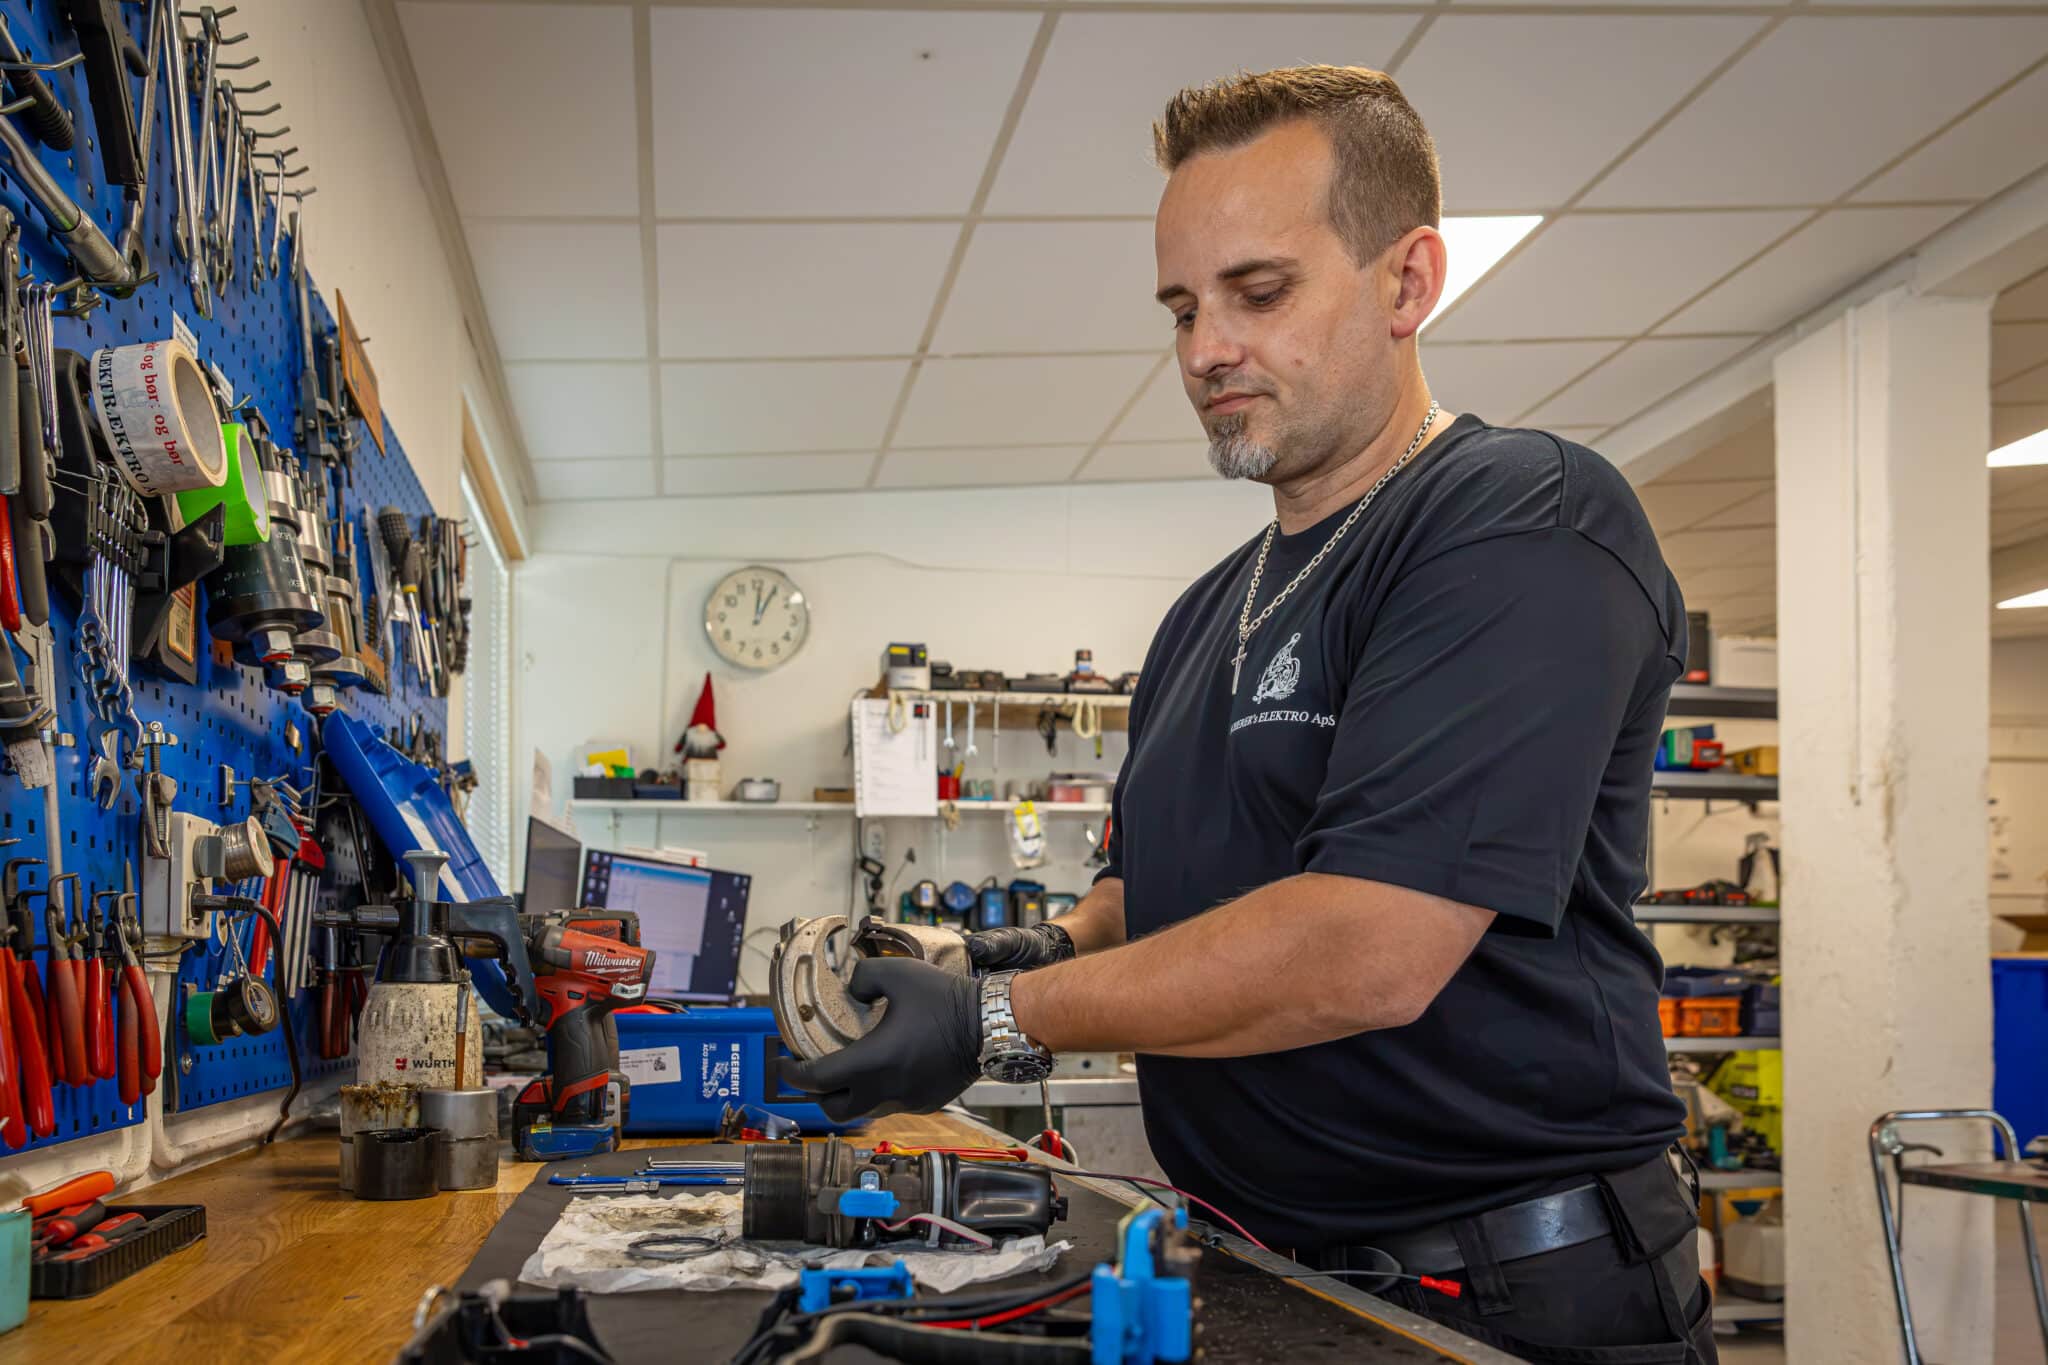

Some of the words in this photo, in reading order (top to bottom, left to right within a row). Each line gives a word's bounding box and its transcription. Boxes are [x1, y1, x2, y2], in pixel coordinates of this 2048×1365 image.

[140, 355, 153, 370] og
[154, 414, 169, 436] og
[164, 440, 184, 466] bør
[1258, 710, 1309, 723] ELEKTRO
[1310, 713, 1336, 728] ApS
[584, 950, 641, 967] Milwaukee
[730, 1052, 740, 1096] GEBERIT
